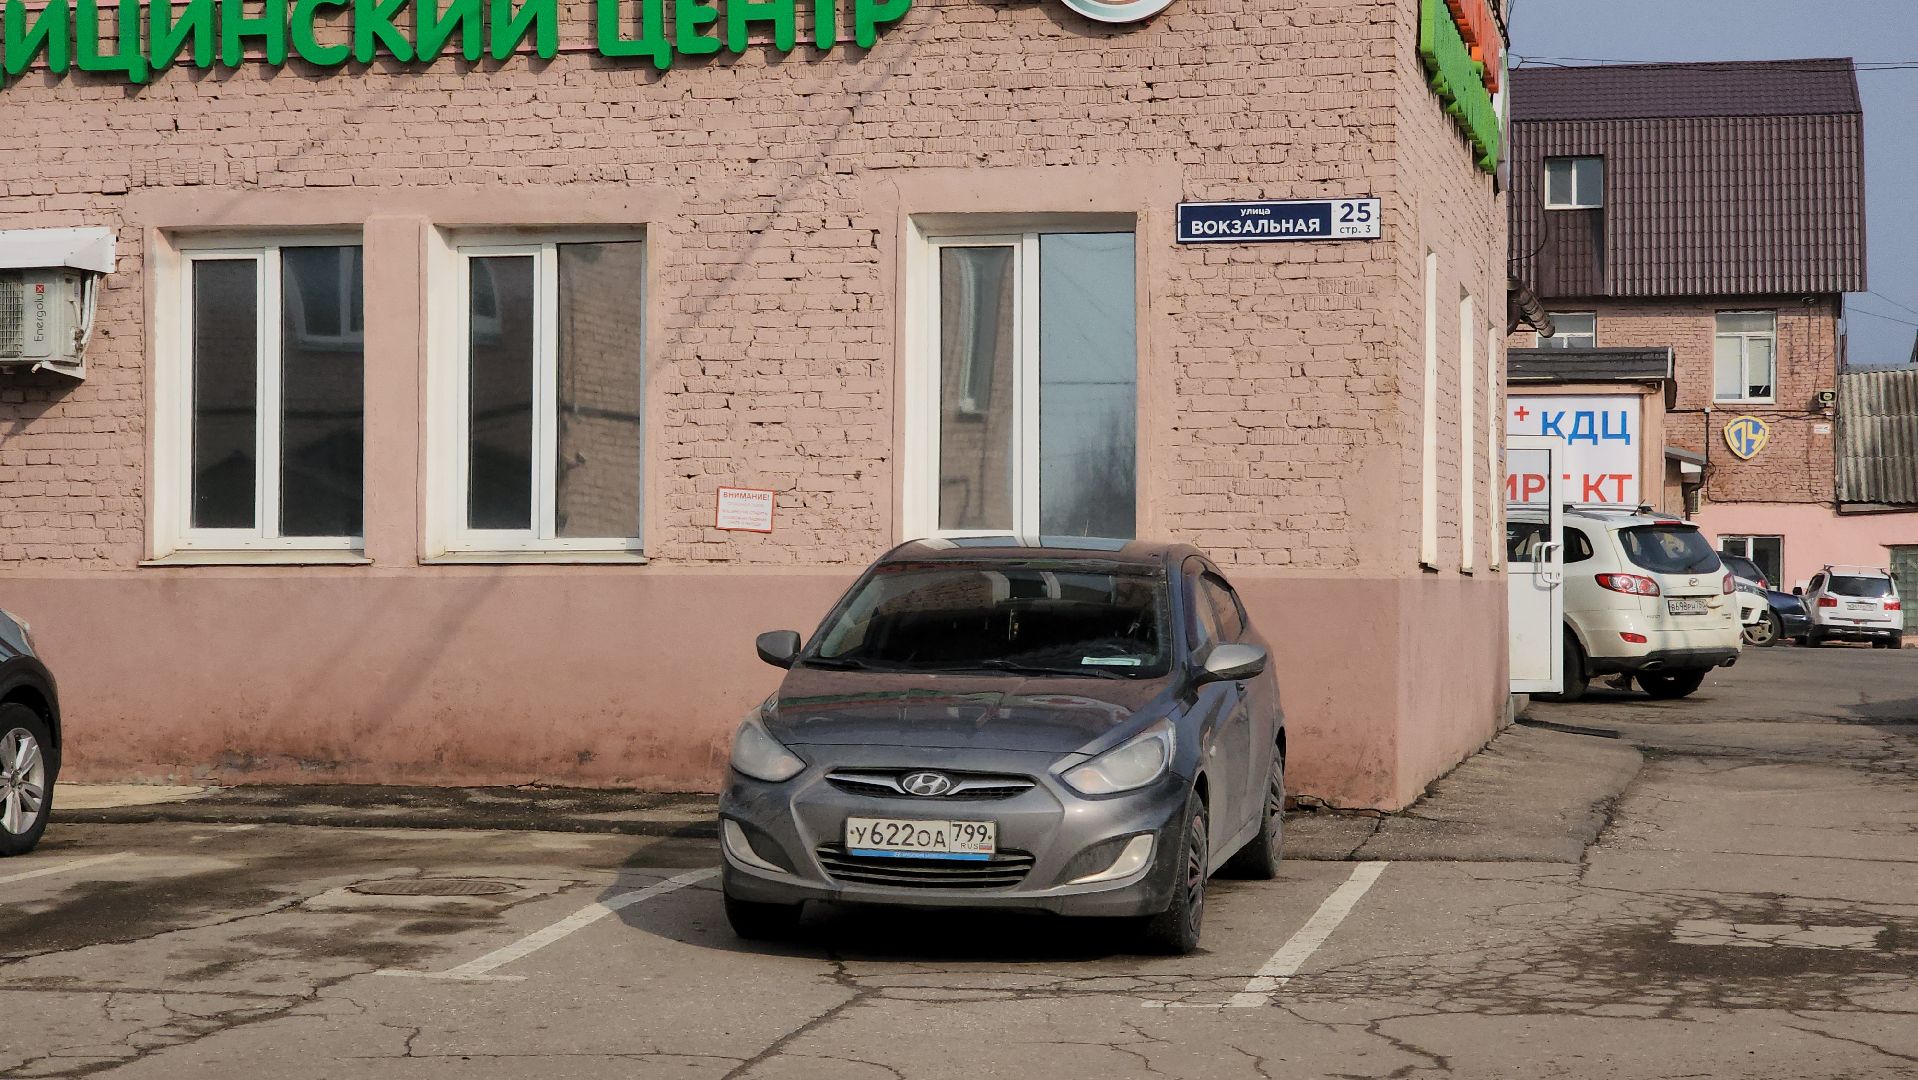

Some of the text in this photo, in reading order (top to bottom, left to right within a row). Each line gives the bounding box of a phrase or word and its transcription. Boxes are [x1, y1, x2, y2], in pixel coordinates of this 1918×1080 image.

[1240, 207, 1271, 216] улица
[1339, 203, 1371, 223] 25
[1191, 219, 1320, 235] ВОКЗАЛЬНАЯ
[1339, 224, 1371, 235] стр. 3
[34, 284, 46, 342] Energolux
[1541, 411, 1631, 445] КДЦ
[723, 491, 770, 501] ВНИМАНИЕ!
[1583, 473, 1632, 502] КТ
[855, 822, 988, 848] У622ОА 799
